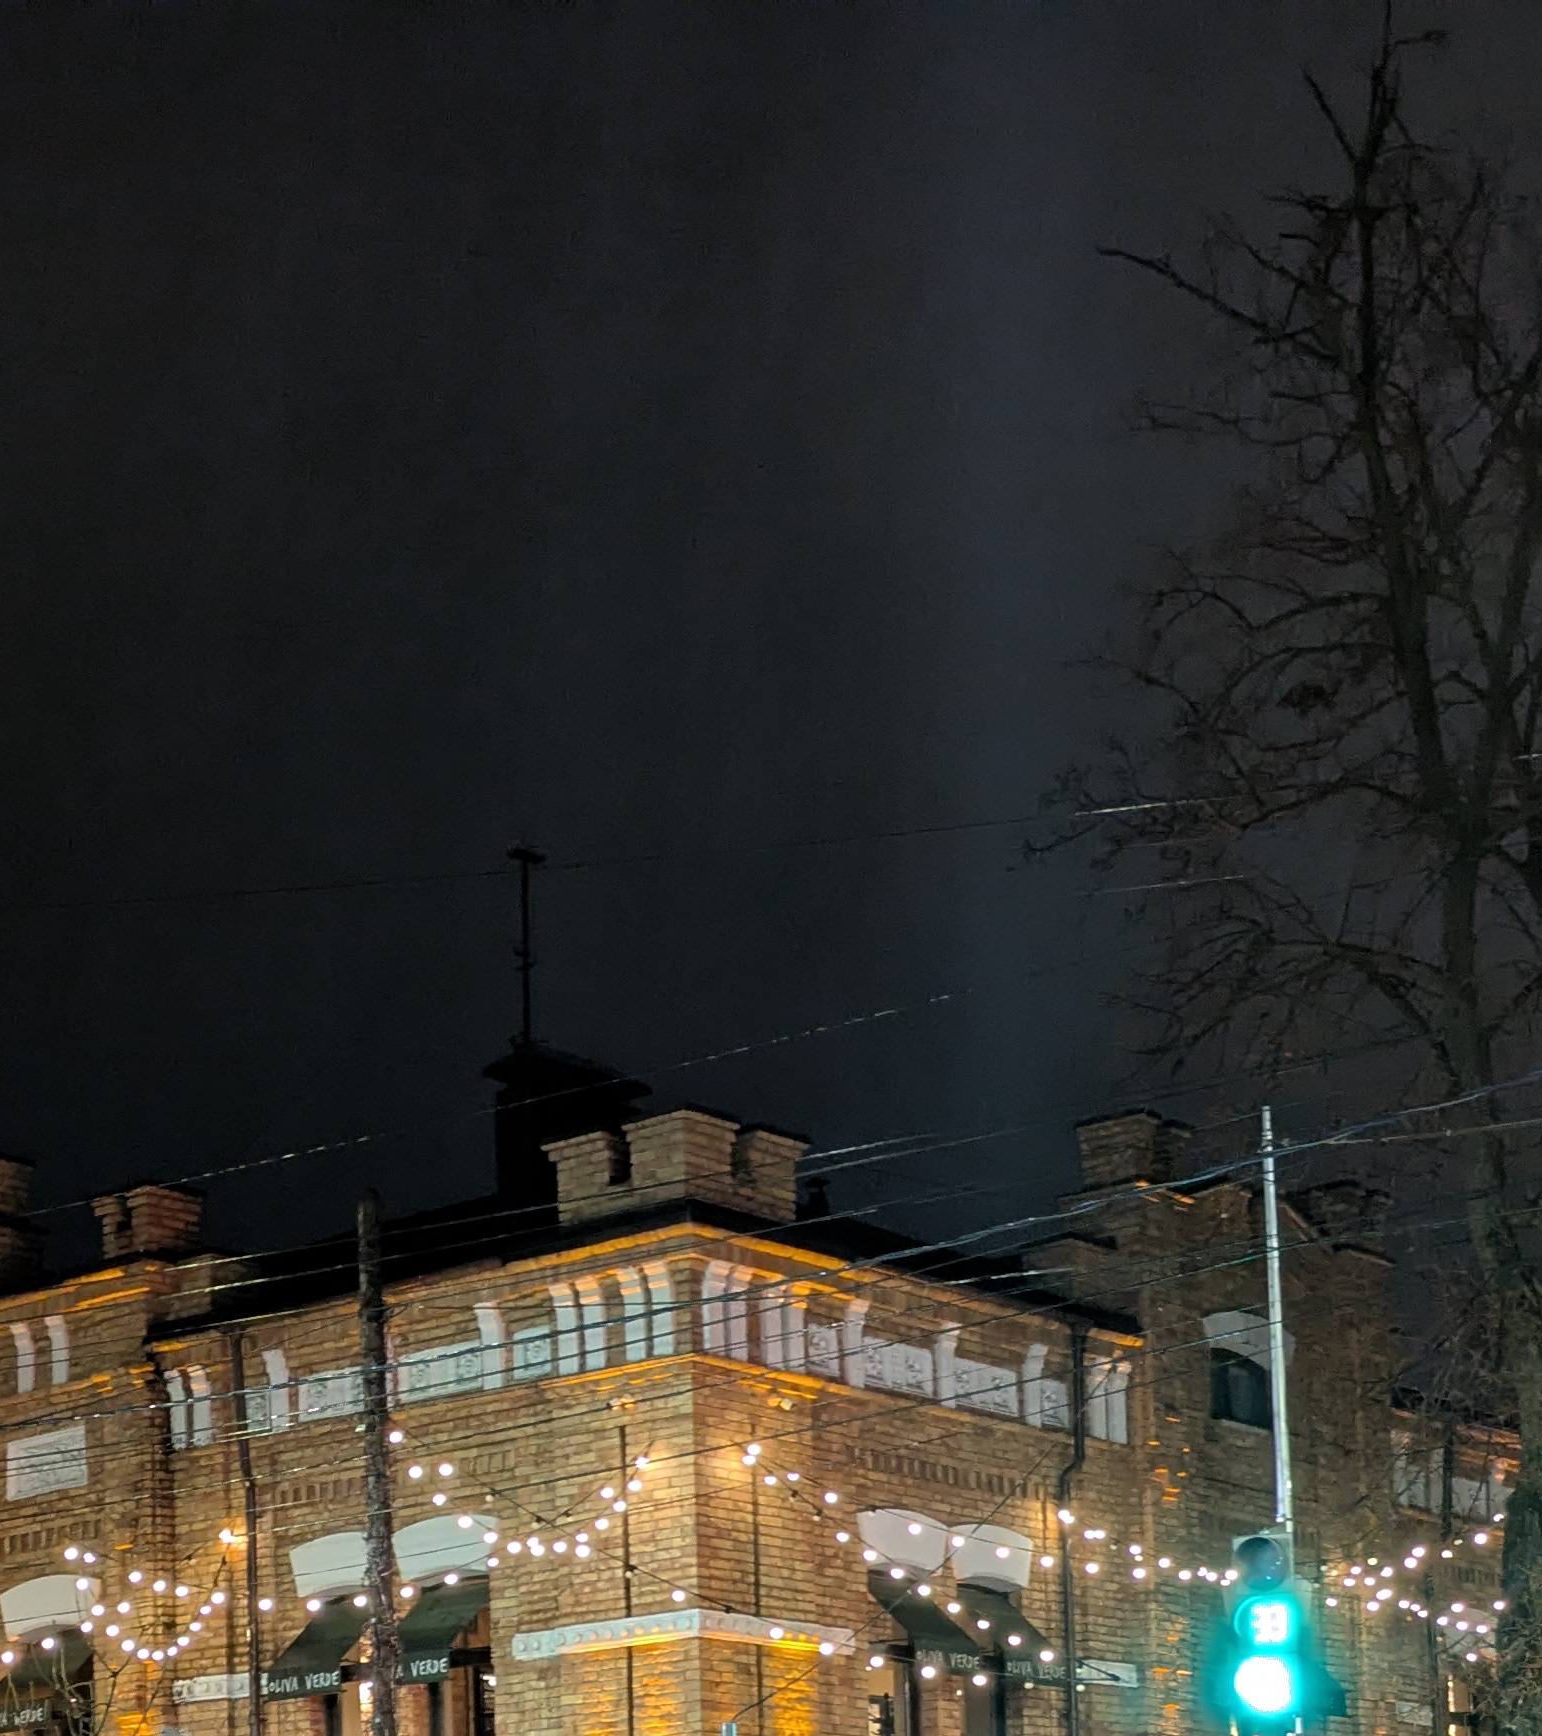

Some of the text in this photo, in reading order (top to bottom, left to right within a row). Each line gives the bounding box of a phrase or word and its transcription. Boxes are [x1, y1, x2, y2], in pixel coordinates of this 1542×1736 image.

[410, 1657, 449, 1677] VERDE
[949, 1652, 980, 1670] VERDE
[268, 1670, 340, 1693] OLIVA VERDE
